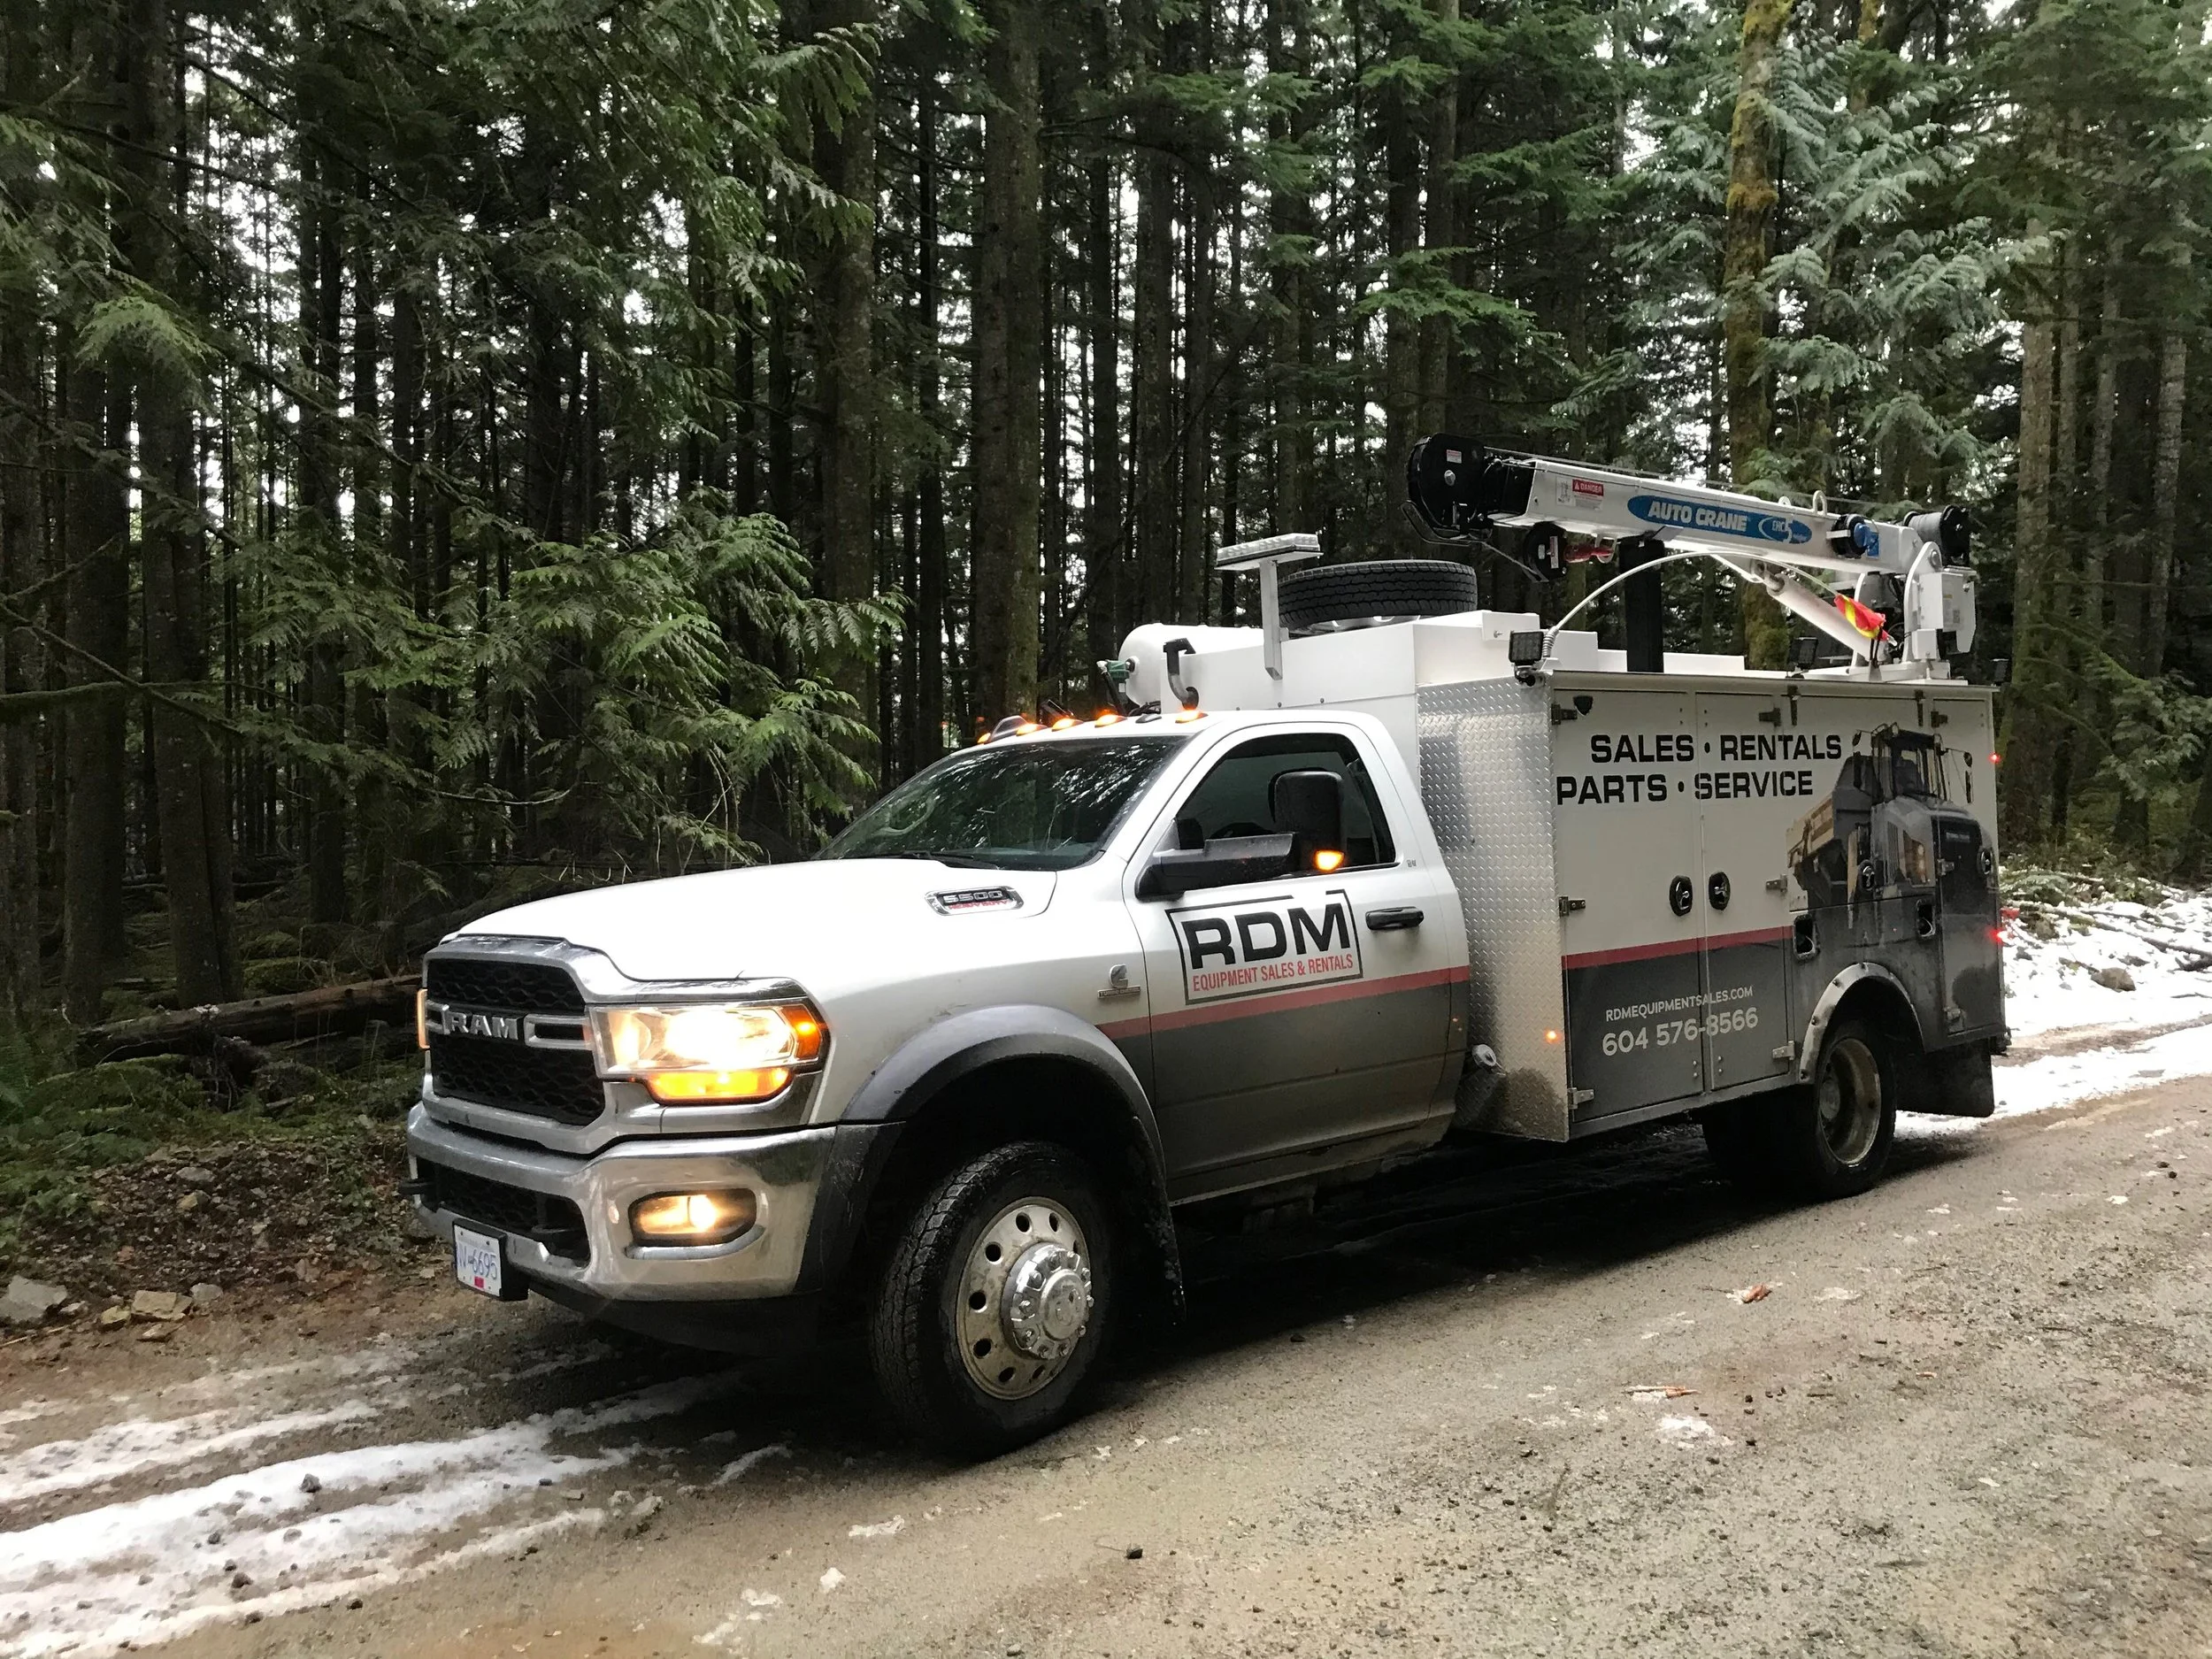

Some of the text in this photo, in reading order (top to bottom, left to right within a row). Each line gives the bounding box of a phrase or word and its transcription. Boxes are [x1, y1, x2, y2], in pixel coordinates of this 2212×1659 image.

[1648, 502, 1748, 531] AUTO CRANE
[1590, 734, 1841, 763] SALES RENTALS
[1556, 771, 1813, 805] PARTS SERVICE
[943, 890, 1003, 902] 5500
[1181, 902, 1350, 970] RDM
[1193, 954, 1353, 992] EQUIPMENT SALES & RENTALS
[1606, 987, 1754, 1022] RDMEQUIPMENTSALES.COM
[444, 1010, 518, 1040] RAM
[1602, 1007, 1759, 1056] 604 576-8566
